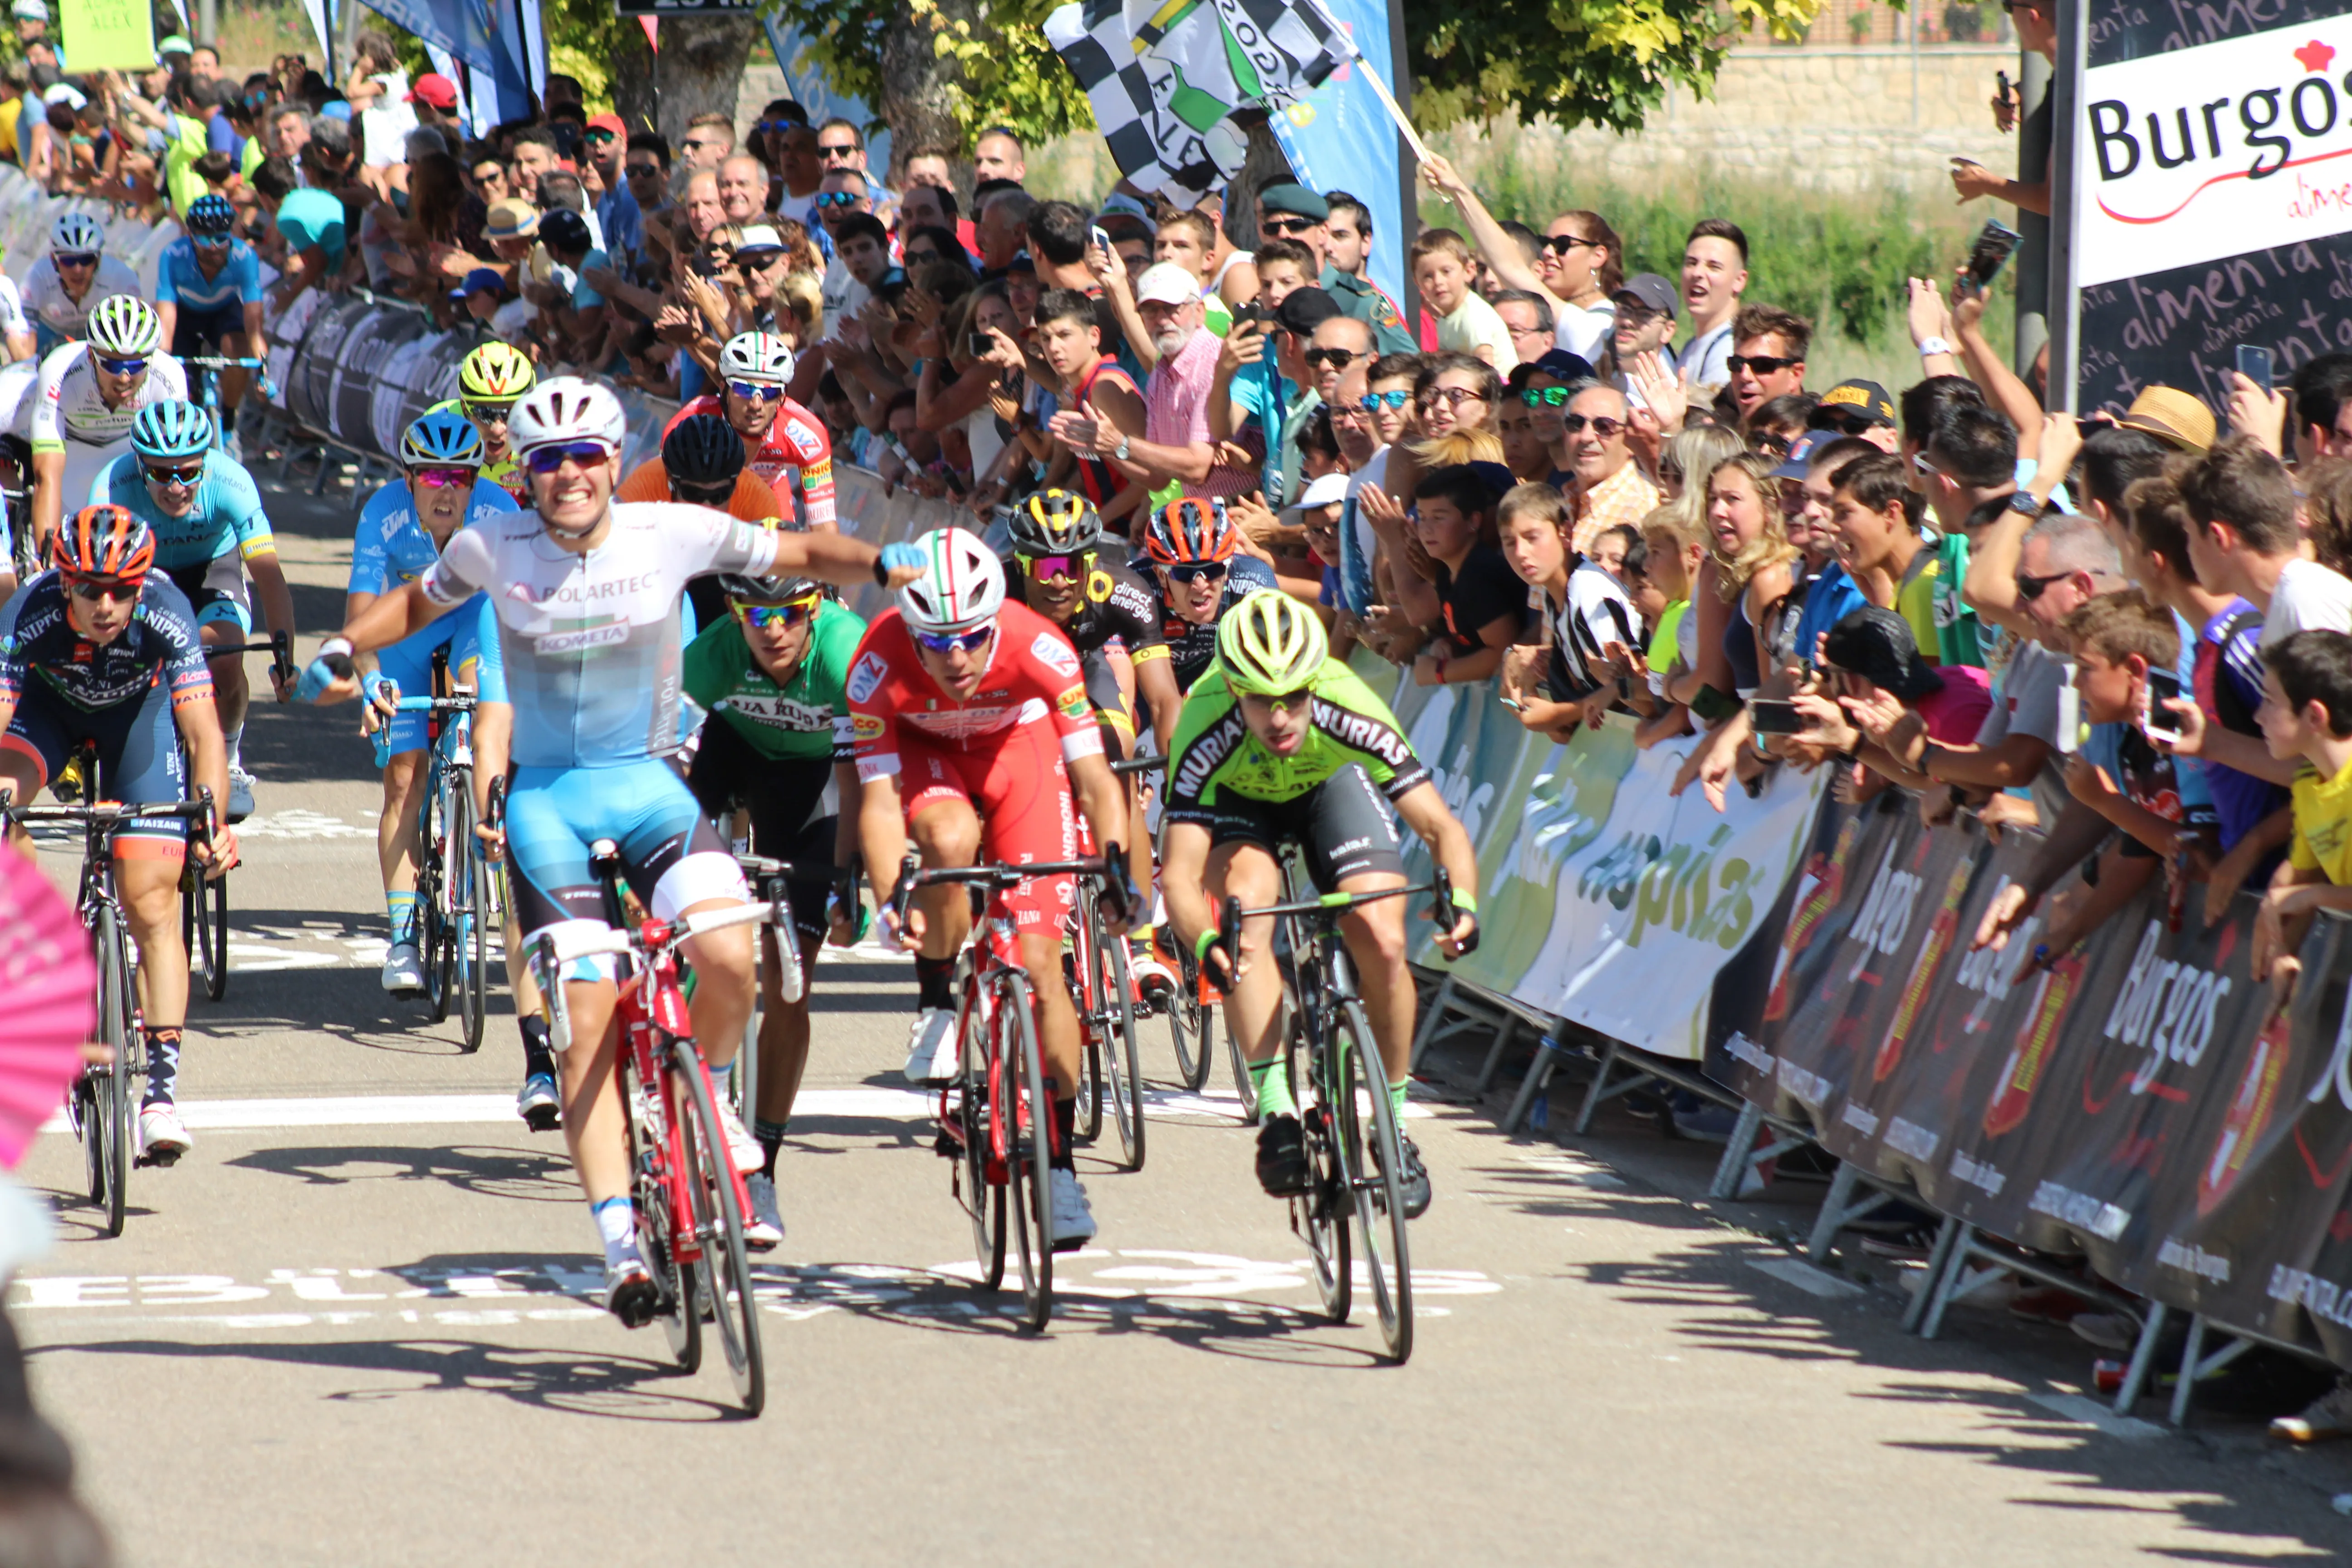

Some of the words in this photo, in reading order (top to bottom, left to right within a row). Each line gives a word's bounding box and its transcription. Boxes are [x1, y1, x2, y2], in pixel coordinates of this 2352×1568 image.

[2088, 69, 2352, 181] Burgo
[2288, 172, 2352, 220] alime
[787, 425, 821, 457] OMZ
[543, 573, 653, 603] POLARTEC
[1114, 581, 1153, 608] direct
[1110, 593, 1153, 625] energie
[145, 609, 189, 649] NIPPO
[540, 627, 624, 652] KOMETA
[166, 652, 205, 671] FANTI
[1034, 638, 1078, 676] OMZ
[853, 658, 884, 701] OMZ
[1310, 699, 1410, 766] MURIAS
[1059, 790, 1074, 862] NDRONI
[2104, 920, 2232, 1096] Burgos
